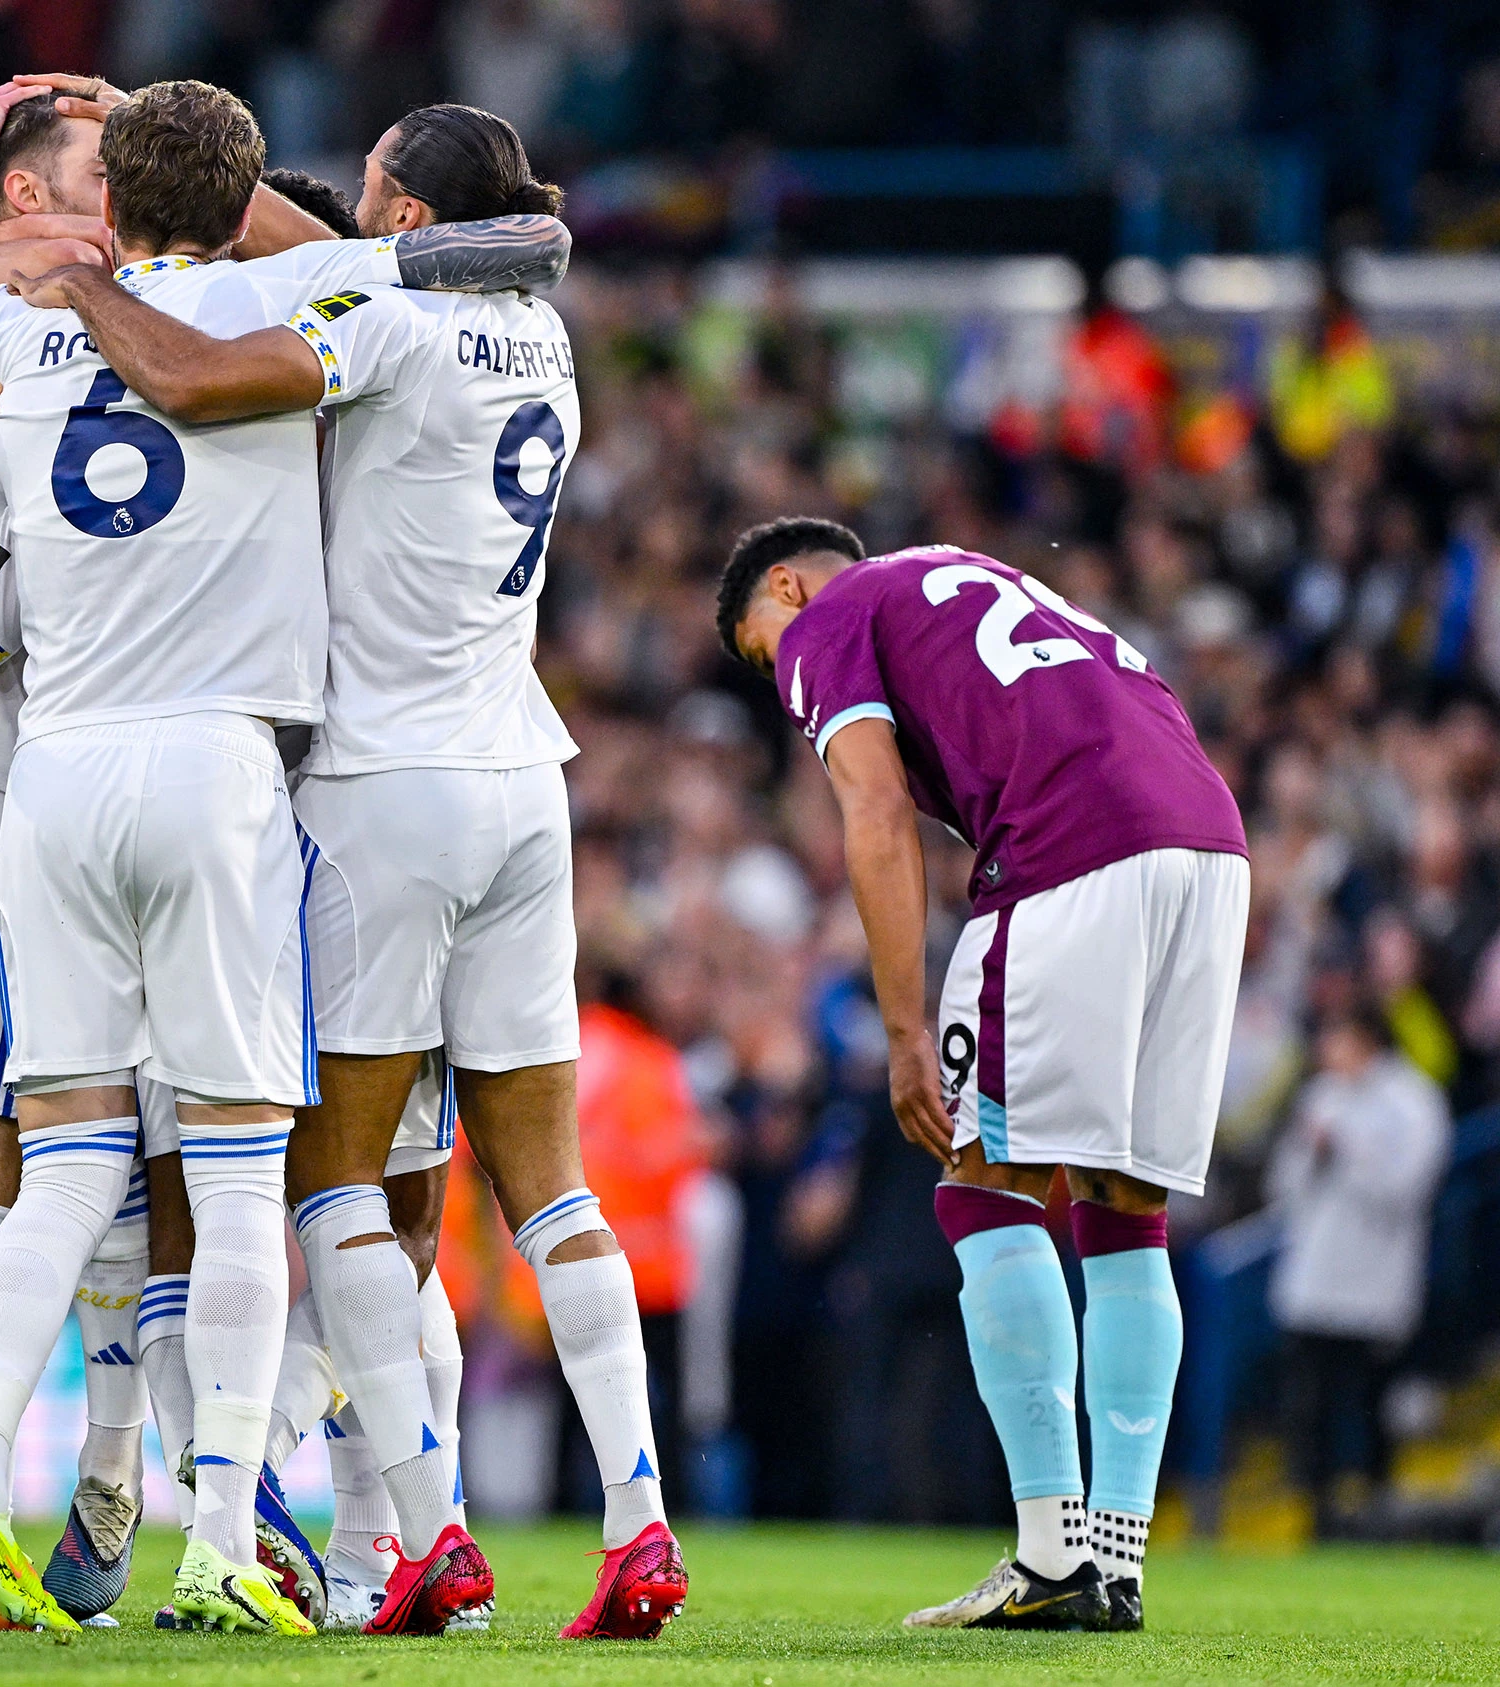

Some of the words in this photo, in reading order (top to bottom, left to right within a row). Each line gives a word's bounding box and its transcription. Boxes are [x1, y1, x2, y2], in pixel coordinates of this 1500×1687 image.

[38, 331, 98, 366] RO
[457, 329, 573, 379] CALVERT-LE
[51, 367, 186, 539] 6
[492, 400, 566, 597] 9
[942, 1022, 977, 1095] 9
